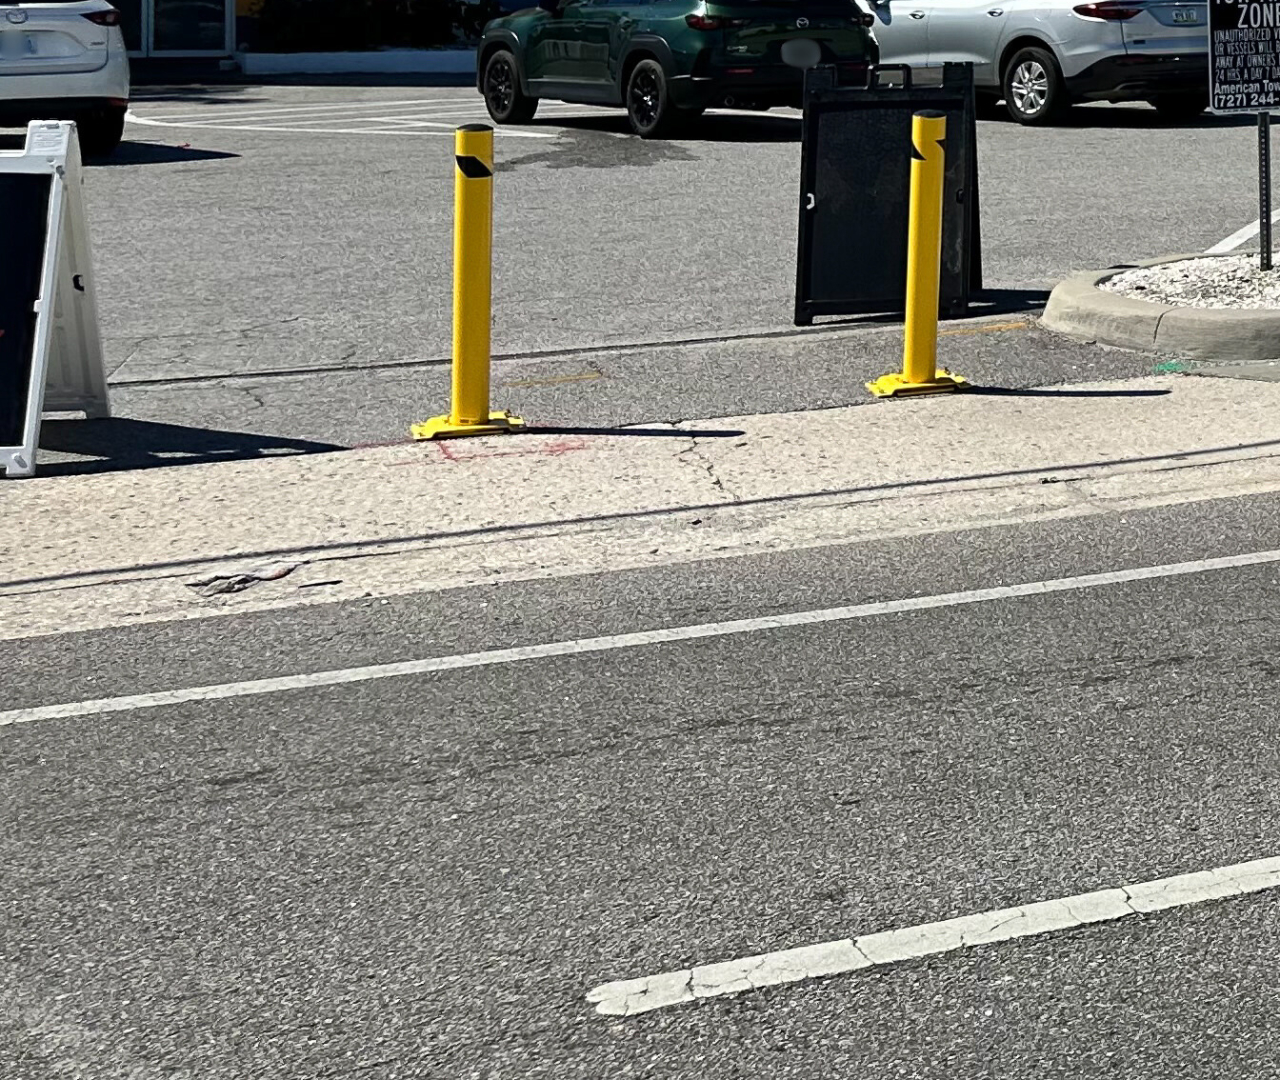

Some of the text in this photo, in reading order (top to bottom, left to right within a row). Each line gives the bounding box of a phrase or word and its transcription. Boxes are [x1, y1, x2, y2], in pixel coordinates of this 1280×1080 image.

[1214, 28, 1271, 42] UNAUTHORIZED
[1214, 43, 1224, 55] OR
[1227, 42, 1256, 55] VESSELS
[1258, 41, 1273, 53] WILL
[1216, 56, 1233, 68] AWAY
[1236, 55, 1244, 67] AT
[1247, 53, 1275, 67] OWNERS
[1215, 69, 1224, 81] 24
[1244, 68, 1249, 80] A
[1251, 67, 1263, 80] DAY
[1265, 67, 1270, 79] 7
[1214, 81, 1260, 94] American
[1214, 94, 1247, 108] (727)
